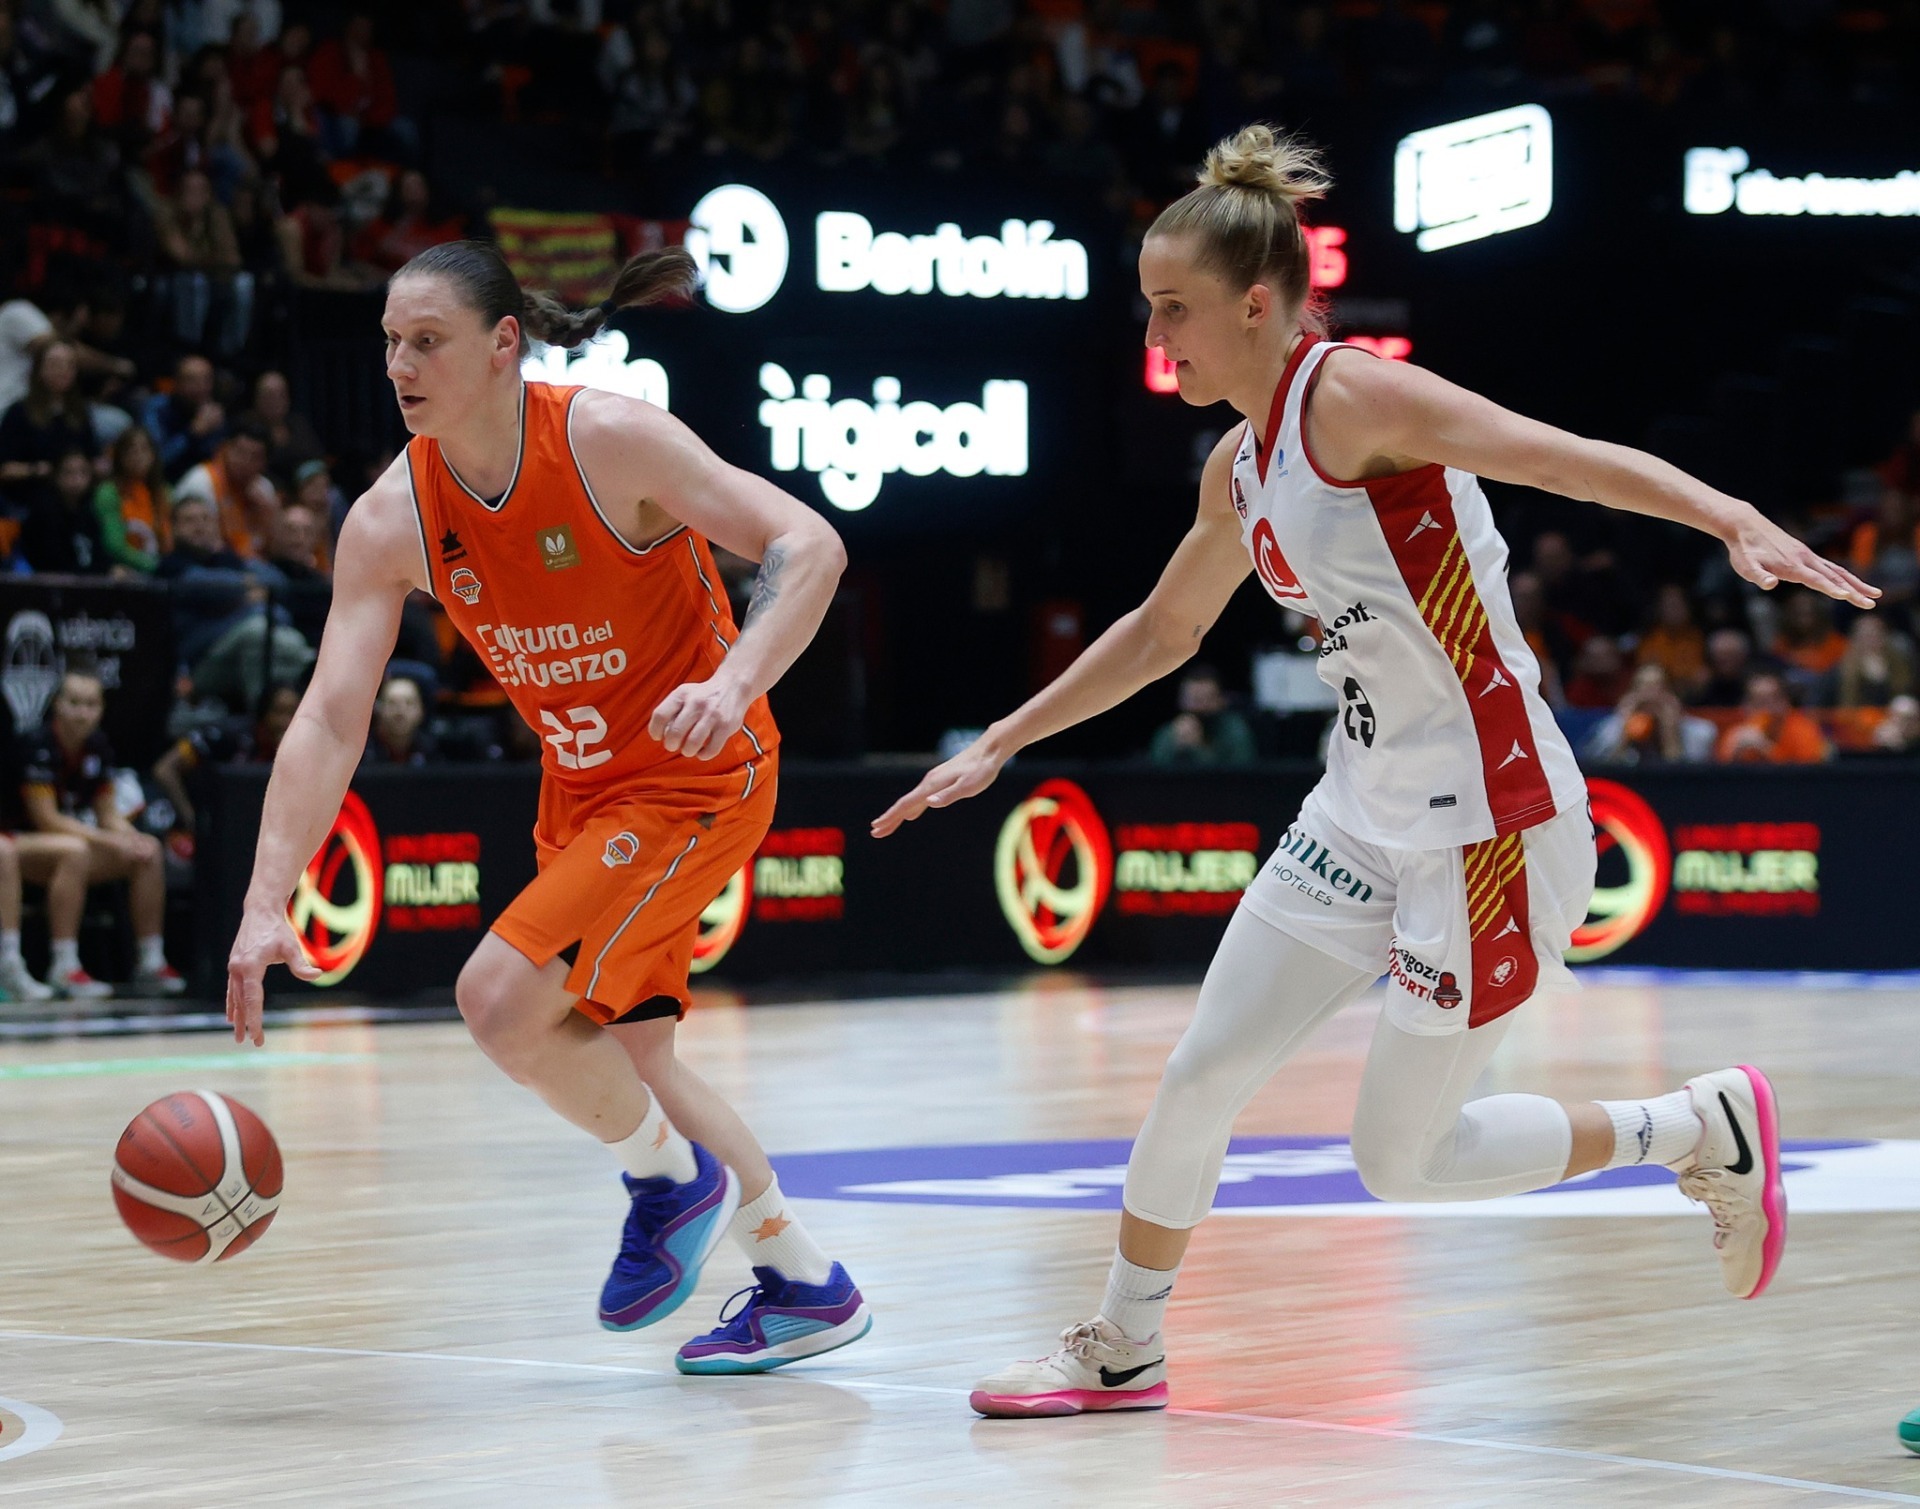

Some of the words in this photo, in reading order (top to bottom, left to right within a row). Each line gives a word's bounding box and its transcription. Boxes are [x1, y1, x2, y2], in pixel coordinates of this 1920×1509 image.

[816, 210, 1089, 300] Bertolín
[476, 623, 580, 655] Cultura
[582, 620, 613, 645] del
[491, 648, 627, 688] Esfuerzo
[1270, 862, 1335, 906] HOTELES
[1279, 827, 1374, 904] Silken
[1388, 946, 1433, 1003] DEPORT
